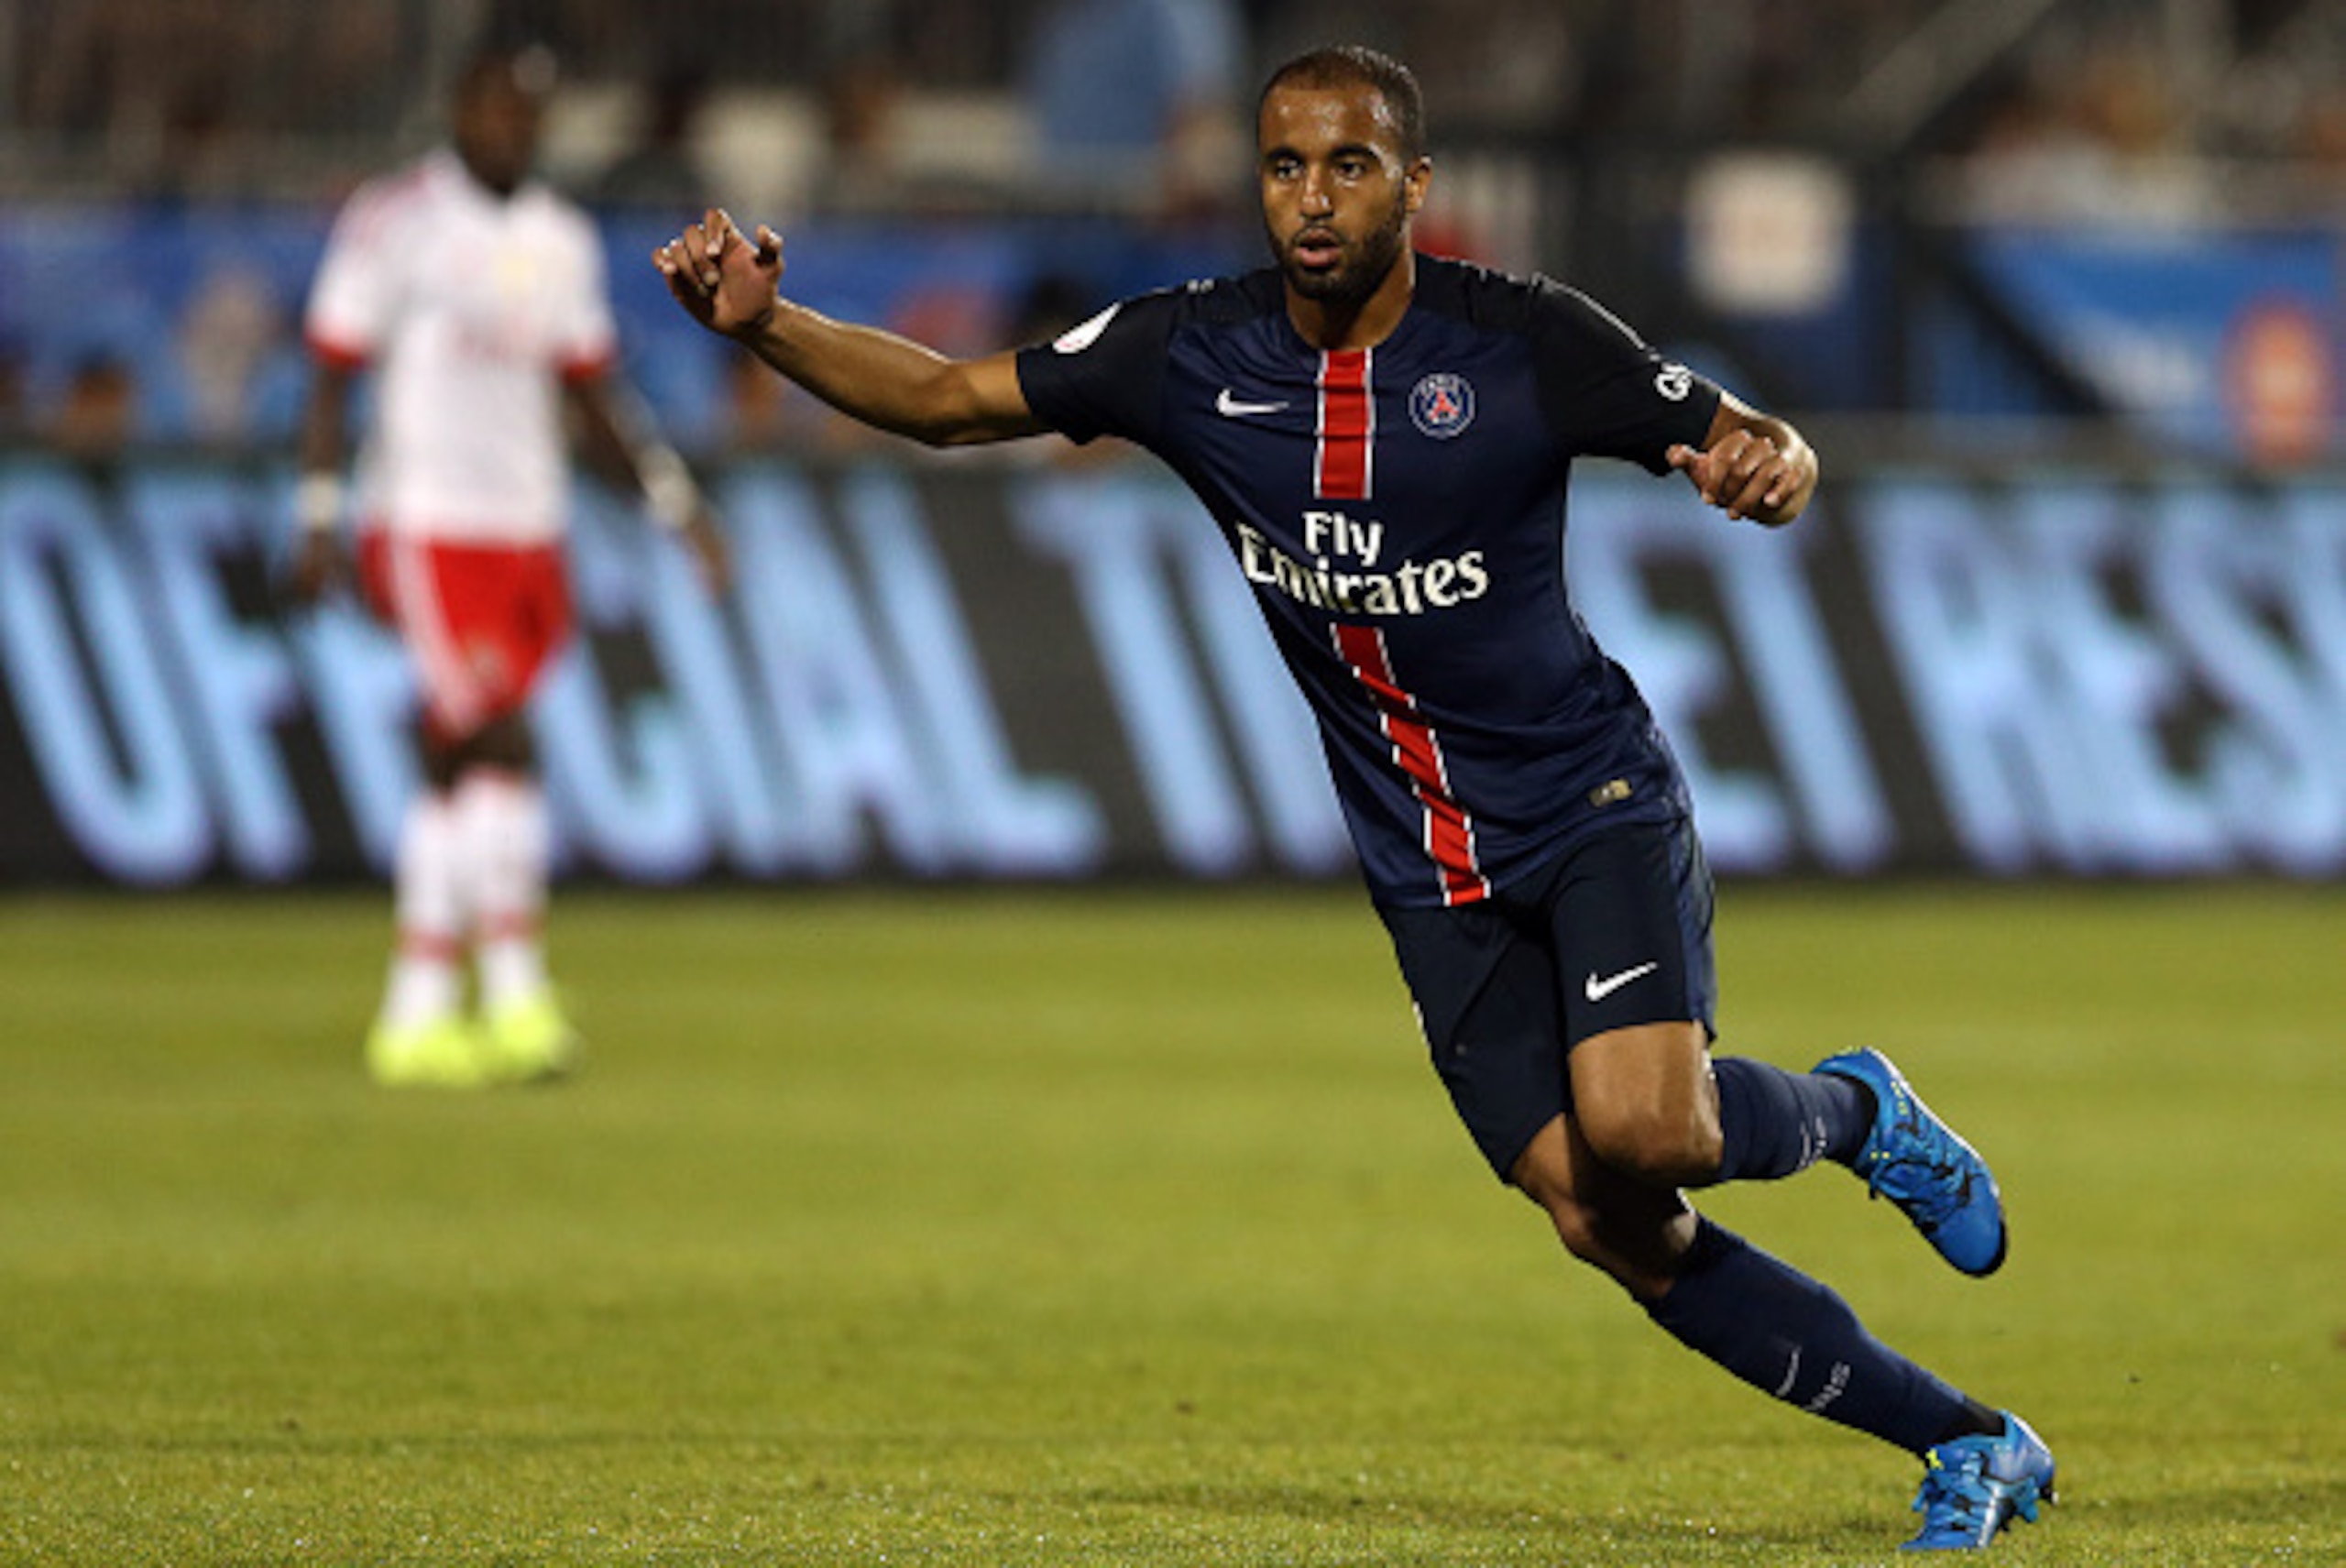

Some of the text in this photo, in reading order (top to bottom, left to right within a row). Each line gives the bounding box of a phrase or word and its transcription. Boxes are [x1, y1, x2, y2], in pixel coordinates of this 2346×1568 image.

[1237, 520, 1489, 615] Emirates
[1302, 510, 1385, 567] Fly
[0, 460, 1103, 882] OFFCIAL
[1010, 466, 1890, 878] TIET
